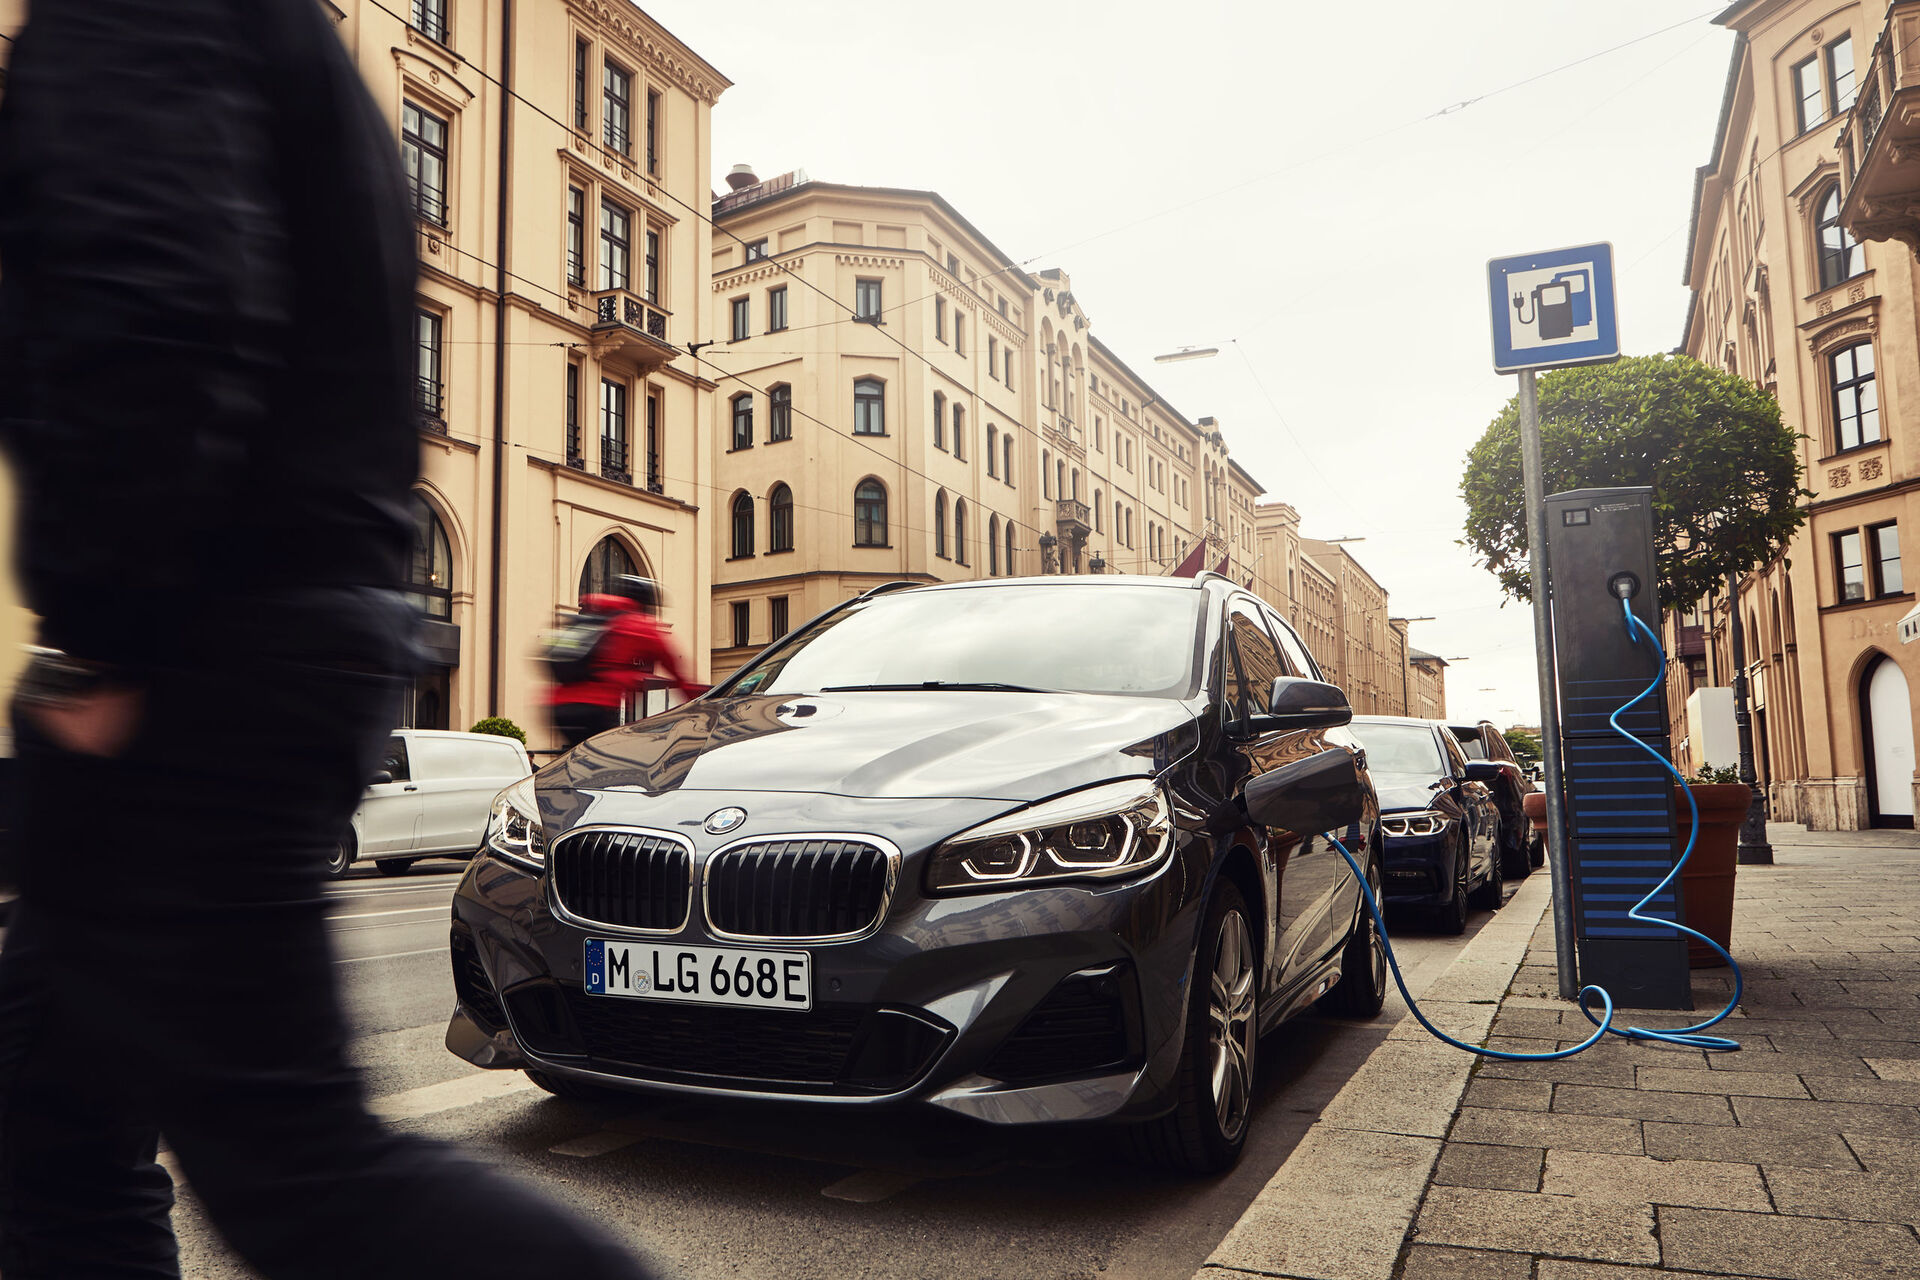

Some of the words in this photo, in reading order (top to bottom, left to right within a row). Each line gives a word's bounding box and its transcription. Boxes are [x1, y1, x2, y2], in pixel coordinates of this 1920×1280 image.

[591, 972, 600, 985] D
[608, 948, 630, 989] M
[653, 950, 699, 994] LG
[710, 955, 807, 1002] 668E
